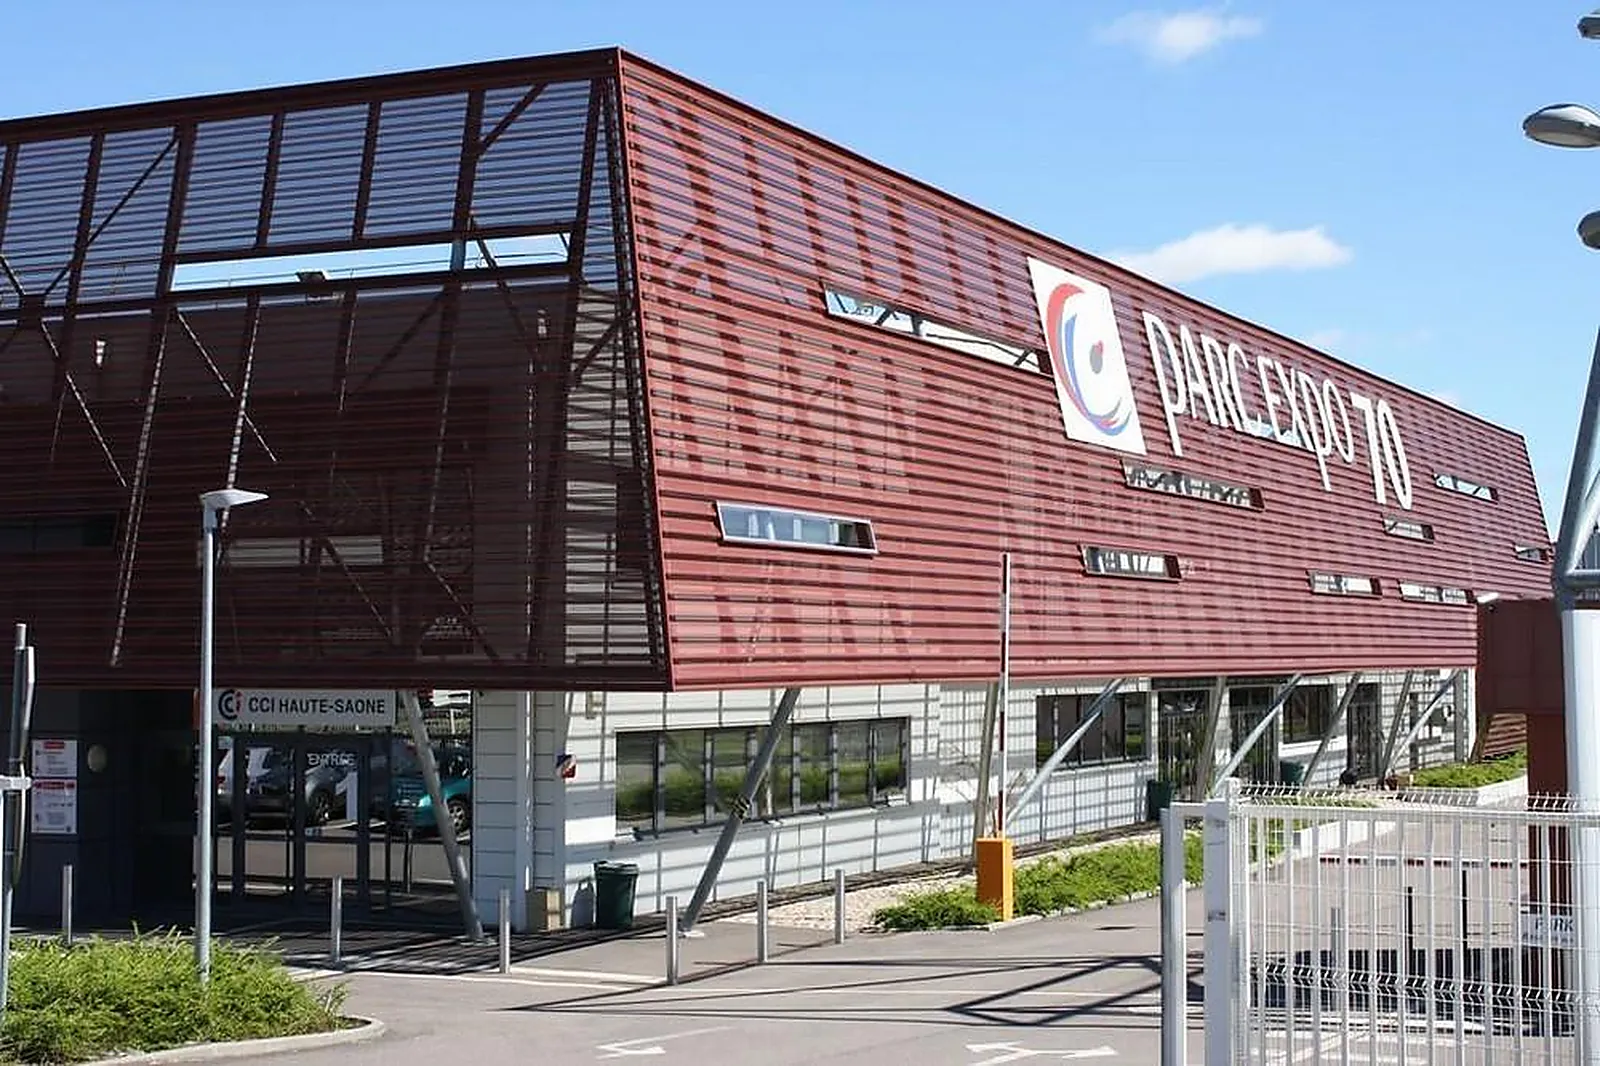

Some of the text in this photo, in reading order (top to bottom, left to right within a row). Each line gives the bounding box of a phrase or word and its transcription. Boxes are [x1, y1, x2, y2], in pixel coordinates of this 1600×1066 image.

[1142, 311, 1413, 511] PARC EXPO 70
[248, 696, 385, 714] CCI HAUTE-SAONE
